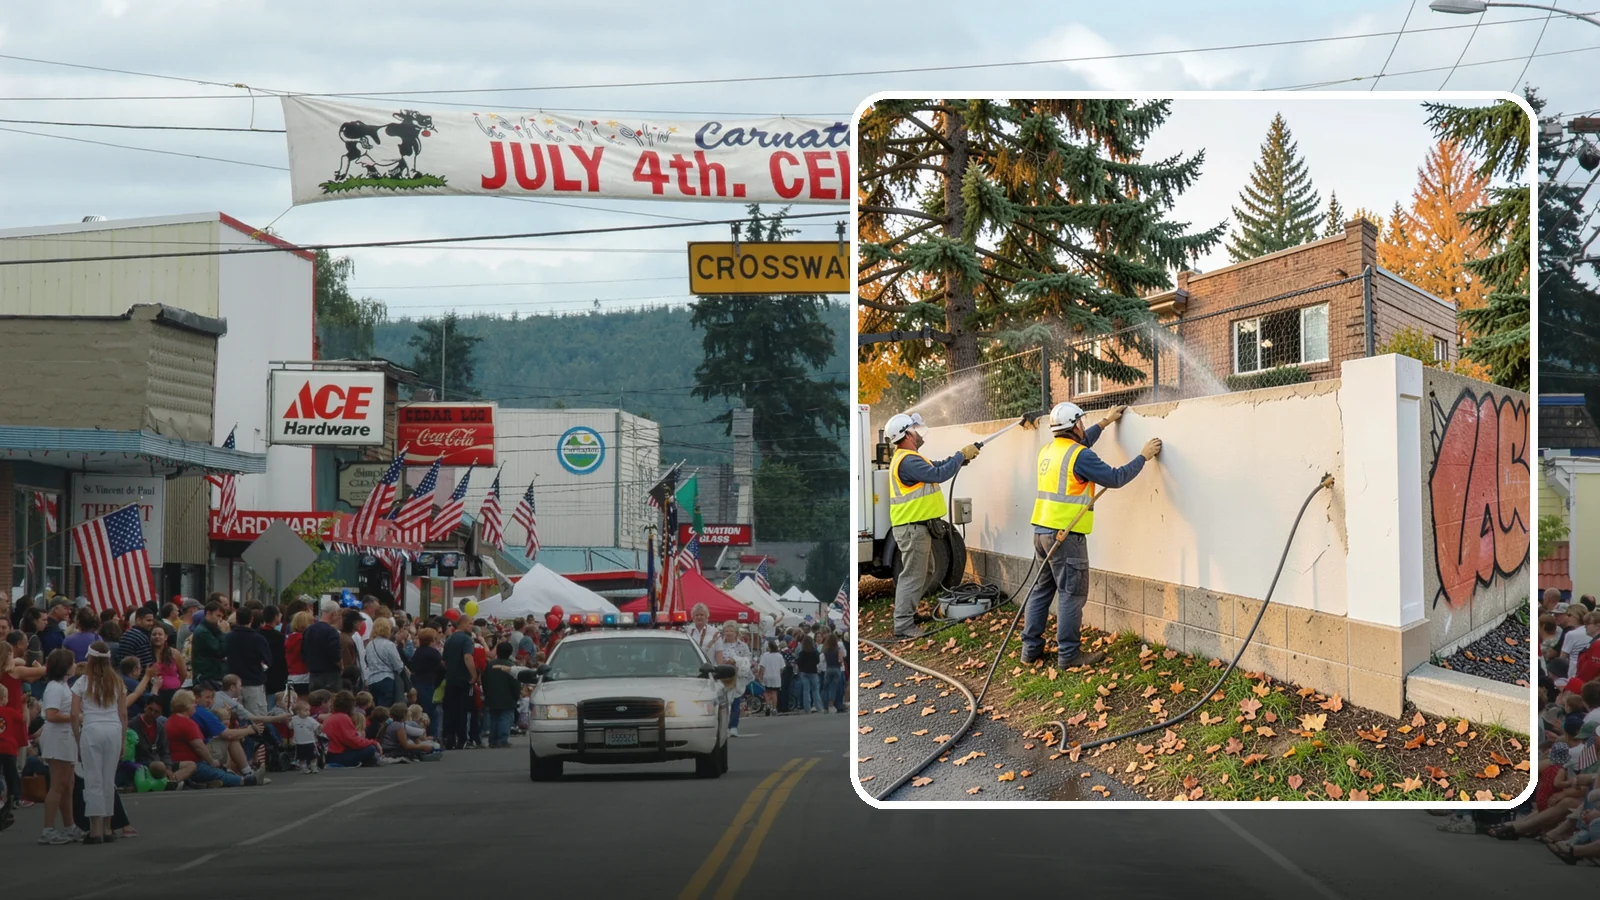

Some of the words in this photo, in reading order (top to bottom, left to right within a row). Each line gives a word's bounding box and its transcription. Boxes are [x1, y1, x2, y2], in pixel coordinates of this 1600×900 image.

[694, 121, 850, 149] Carnat
[481, 141, 604, 192] JULY
[632, 150, 746, 197] 4th.
[697, 254, 850, 280] CROSSWA
[282, 380, 373, 420] ACE
[406, 409, 452, 423] CEDAR
[283, 421, 370, 436] Hardware
[416, 428, 476, 447] Coca-Cola
[353, 467, 386, 480] Simpl
[83, 485, 93, 494] St.
[96, 485, 124, 494] Vincent
[126, 486, 135, 494] de
[138, 486, 155, 495] Paul
[688, 526, 741, 535] CRNATION
[699, 535, 730, 543] GLASS
